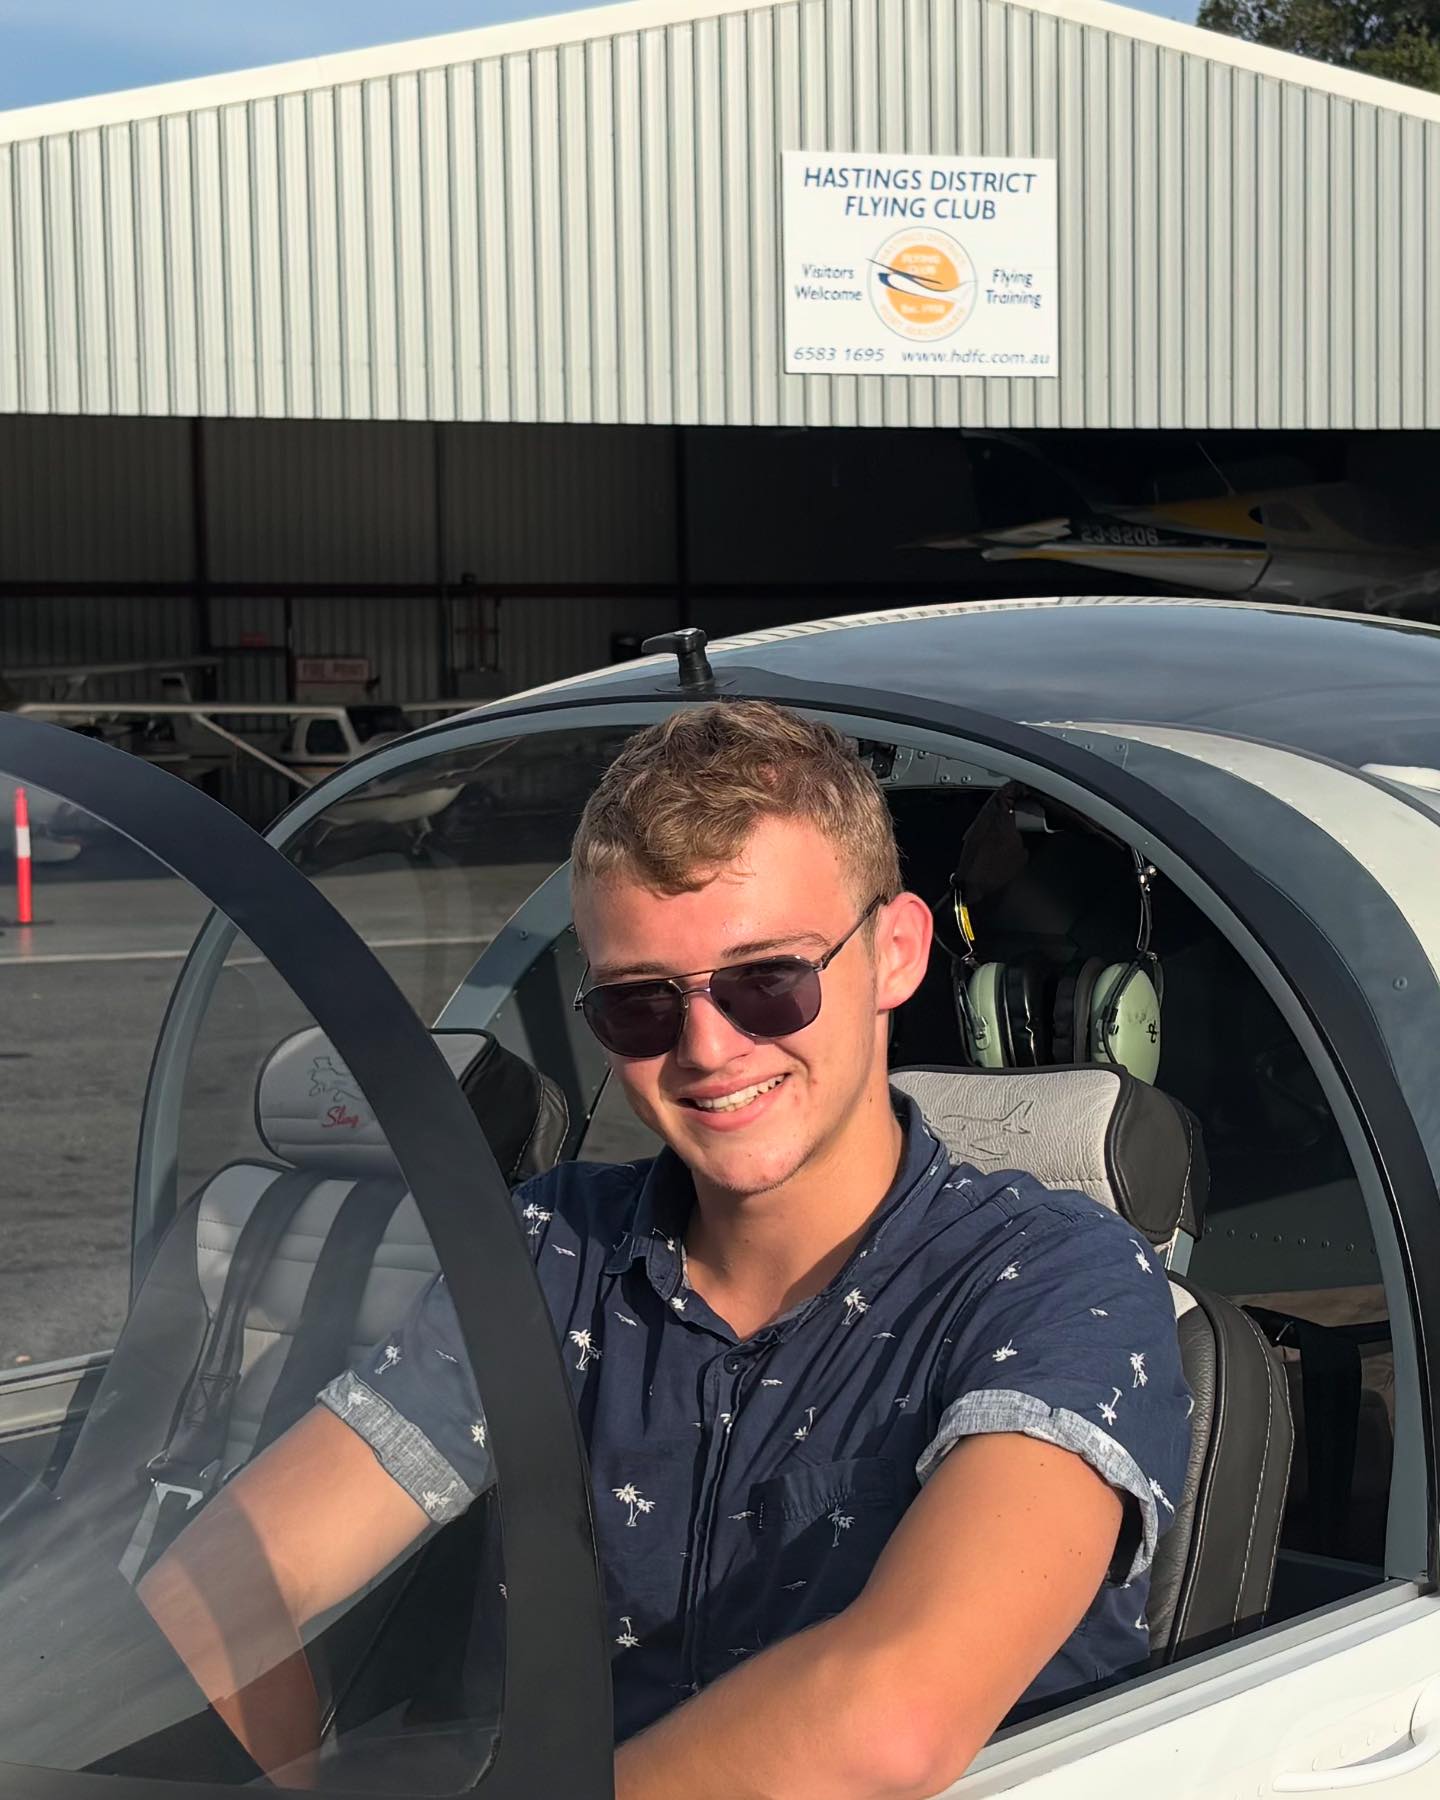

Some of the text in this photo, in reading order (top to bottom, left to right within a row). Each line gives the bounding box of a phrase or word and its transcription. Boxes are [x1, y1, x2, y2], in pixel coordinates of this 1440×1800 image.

[804, 167, 1037, 194] HASTINGS DISTRICT
[845, 195, 996, 220] FLYING CLUB
[802, 264, 854, 280] Visitors
[991, 268, 1033, 288] Flying
[794, 285, 862, 301] Welcome
[986, 289, 1042, 309] Training
[794, 347, 1051, 365] 6583 1695 www.hdfc.com.au
